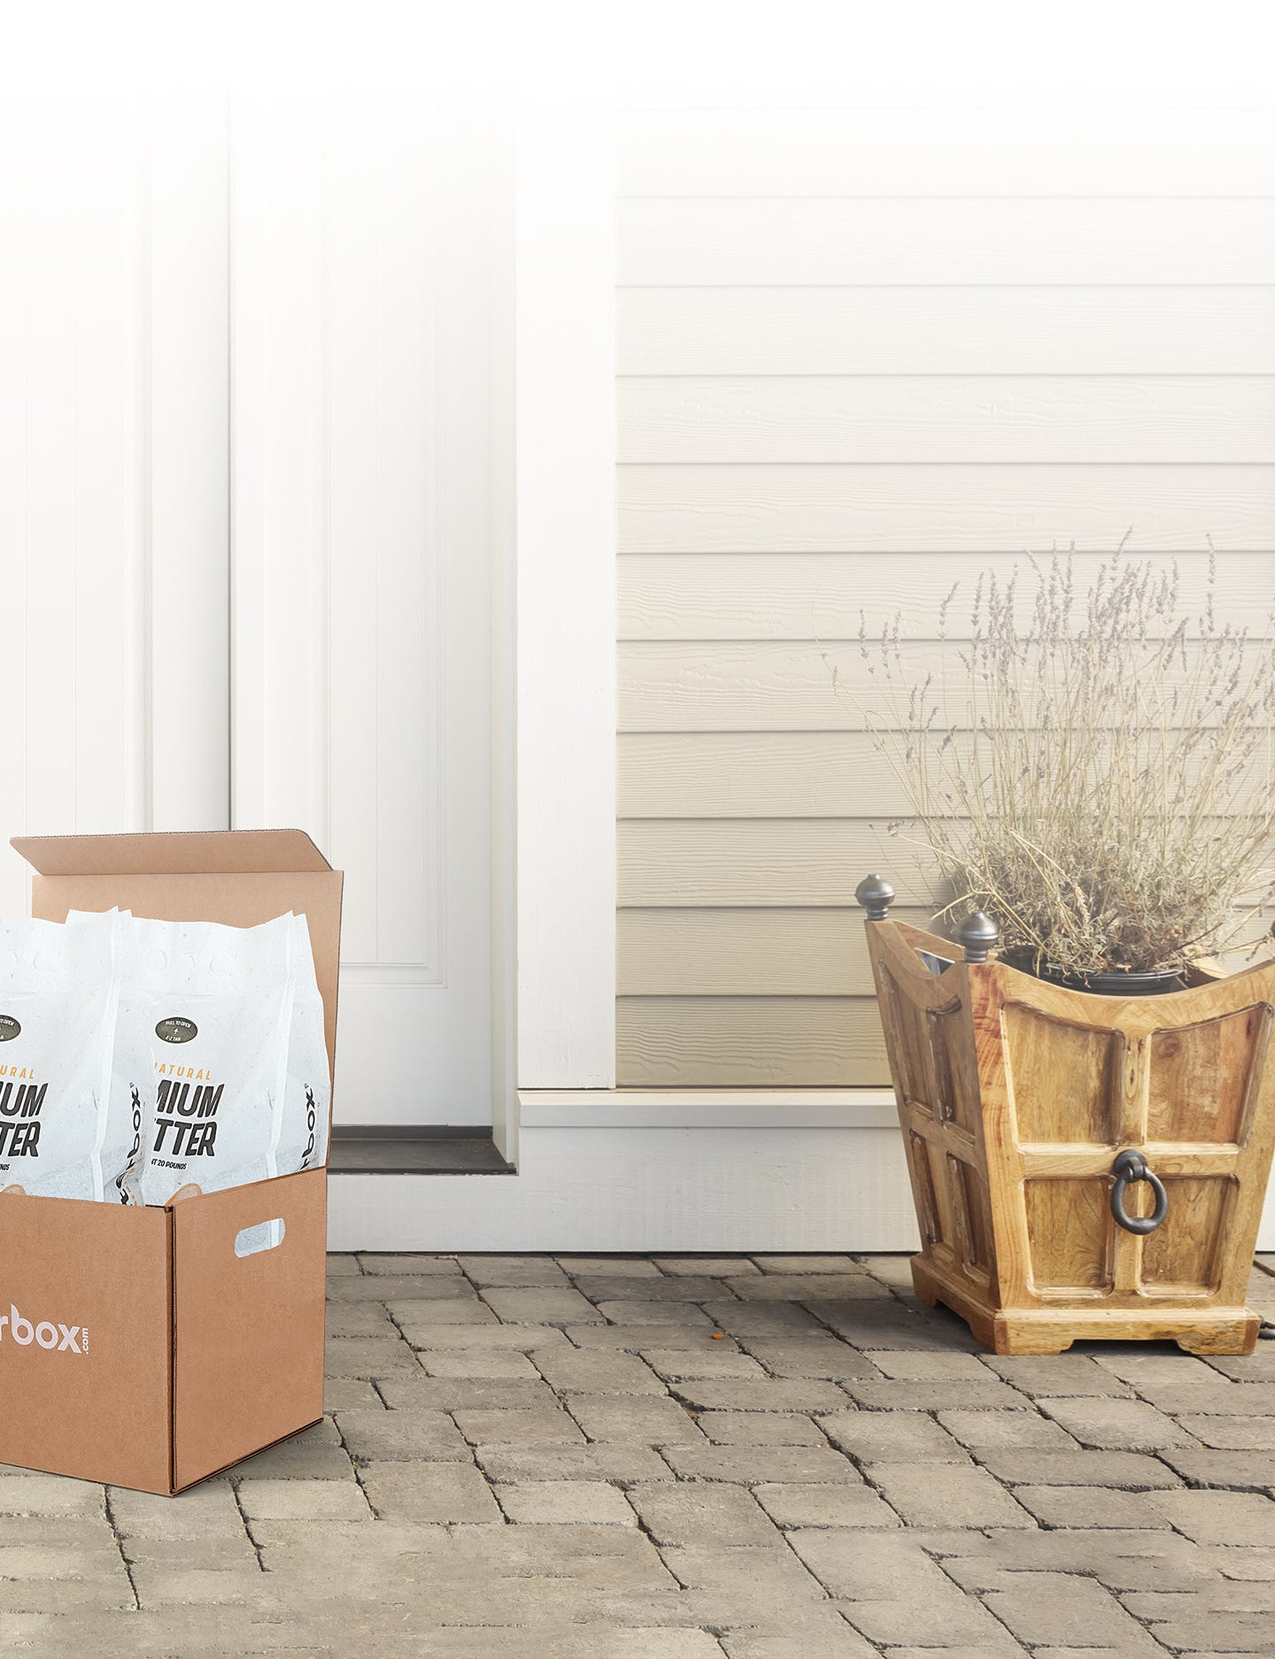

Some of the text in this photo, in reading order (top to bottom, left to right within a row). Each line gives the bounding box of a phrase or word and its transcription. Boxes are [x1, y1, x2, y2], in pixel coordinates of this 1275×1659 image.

[154, 1062, 211, 1080] ATURAL
[157, 1159, 165, 1167] 20
[165, 1160, 187, 1170] POUNDS
